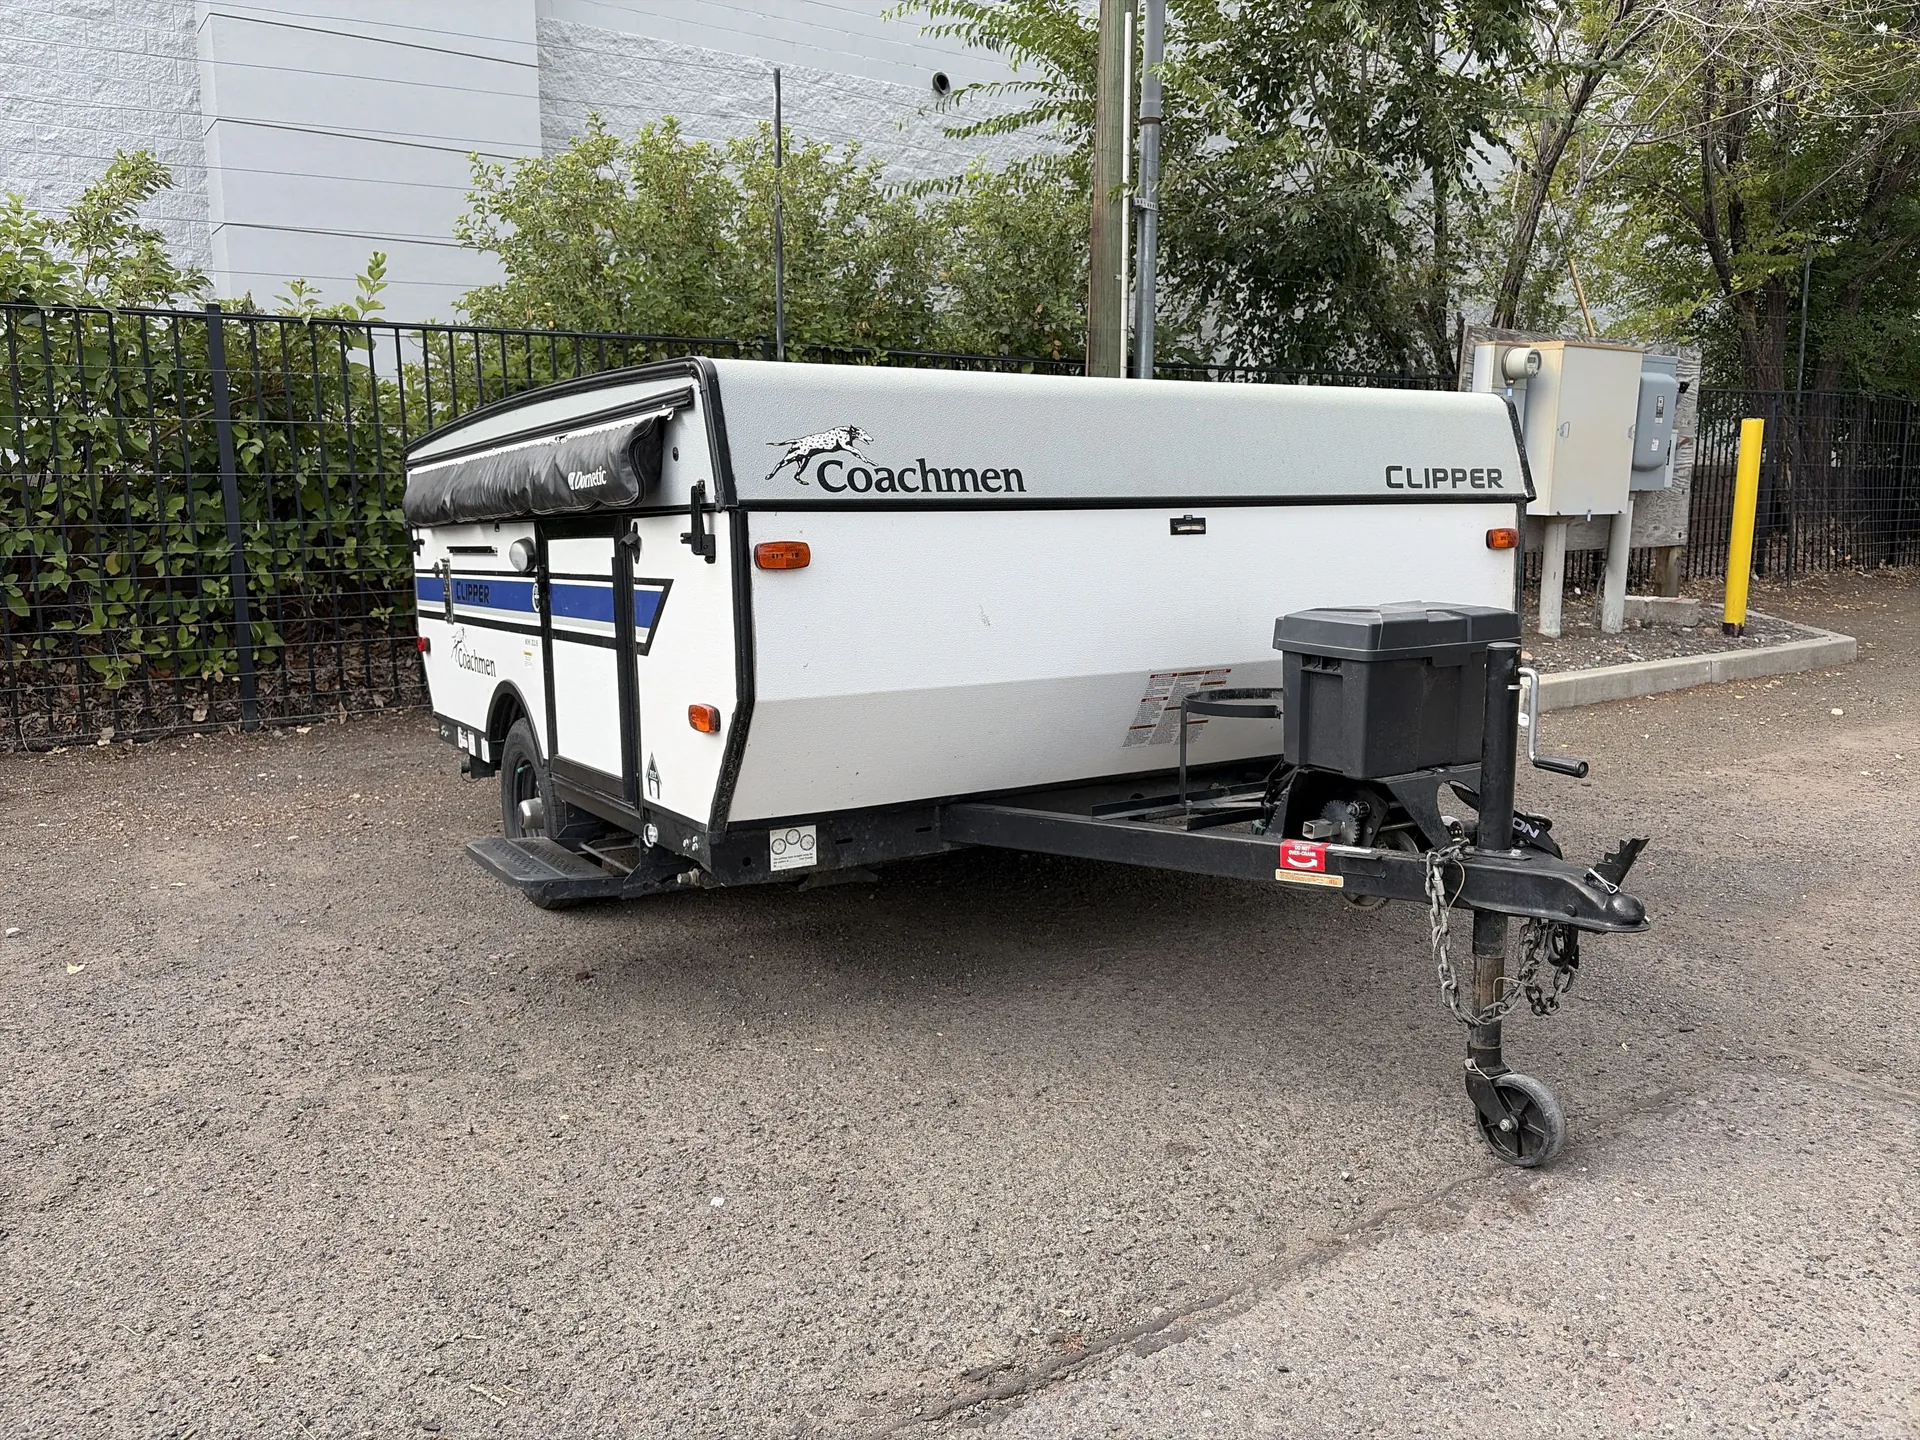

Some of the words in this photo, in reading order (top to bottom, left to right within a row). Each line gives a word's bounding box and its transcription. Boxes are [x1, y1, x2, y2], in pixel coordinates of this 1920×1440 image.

[574, 465, 607, 490] Dometic
[816, 458, 1027, 493] Coachmen
[1385, 465, 1504, 489] CLIPPER
[455, 581, 490, 604] CLIPPER
[458, 647, 497, 677] Coachmen
